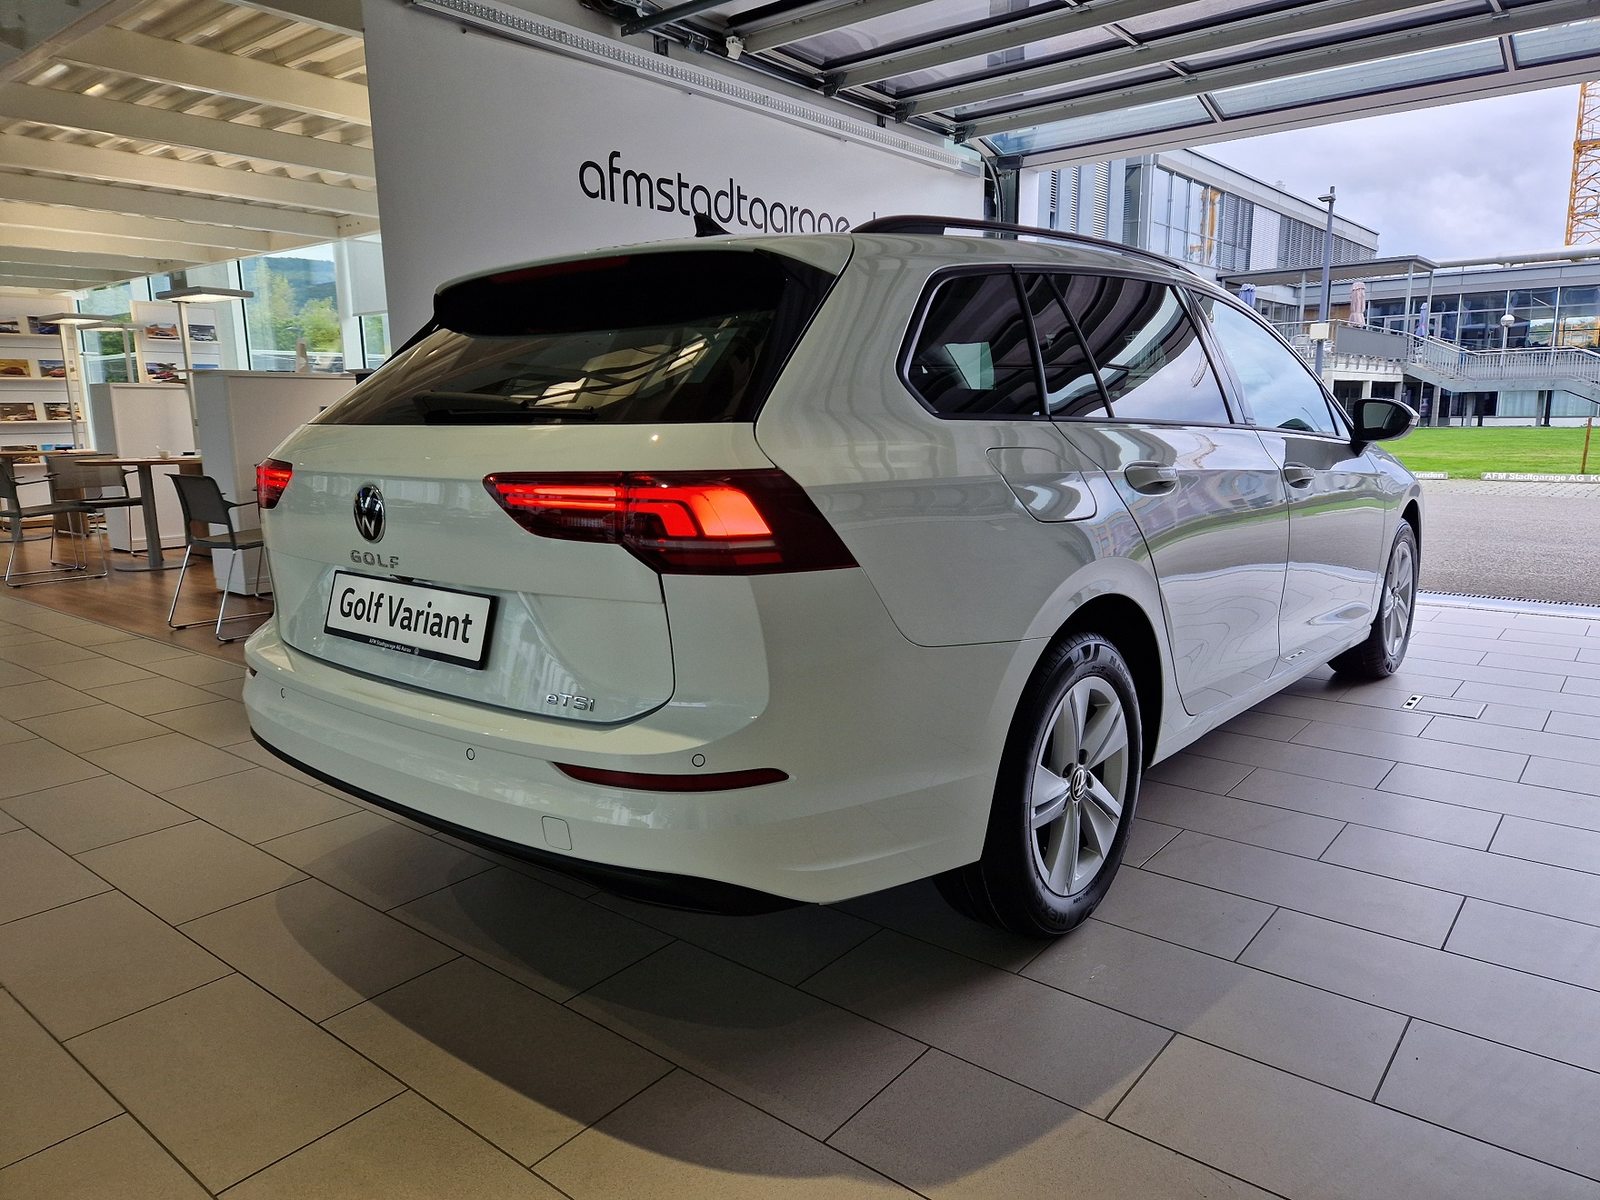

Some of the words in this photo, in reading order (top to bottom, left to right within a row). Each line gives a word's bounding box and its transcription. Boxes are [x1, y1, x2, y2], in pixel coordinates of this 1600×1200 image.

[1484, 472, 1507, 480] AFM
[1508, 472, 1567, 482] Stadtgarage
[1568, 474, 1585, 482] AG
[350, 549, 399, 569] GOLF
[339, 587, 384, 624] Golf
[388, 595, 473, 644] Variant
[546, 692, 595, 712] eTSI
